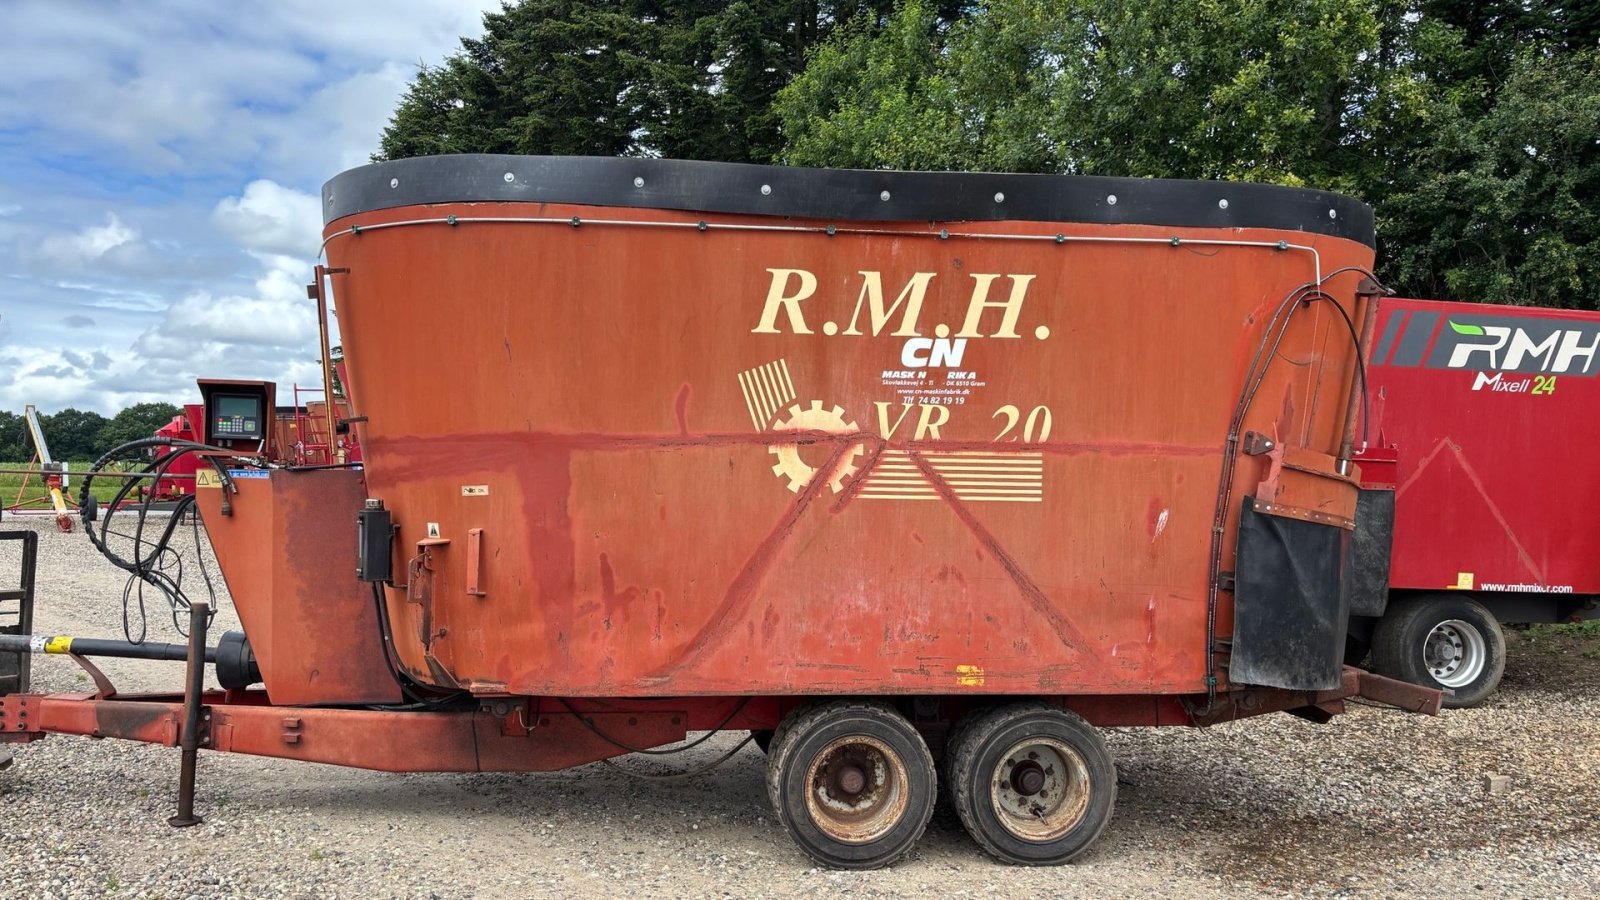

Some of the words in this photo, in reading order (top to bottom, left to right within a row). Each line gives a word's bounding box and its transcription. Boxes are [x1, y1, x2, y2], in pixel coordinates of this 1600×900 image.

[751, 267, 1050, 340] R.M.H.
[901, 337, 968, 368] CN
[1448, 321, 1600, 373] RMH
[918, 396, 928, 404] 74
[930, 396, 940, 404] 82
[943, 396, 953, 404] 19
[1472, 371, 1531, 393] Mixell
[1531, 375, 1557, 395] 24
[873, 401, 950, 442] VR
[990, 404, 1052, 443] 20
